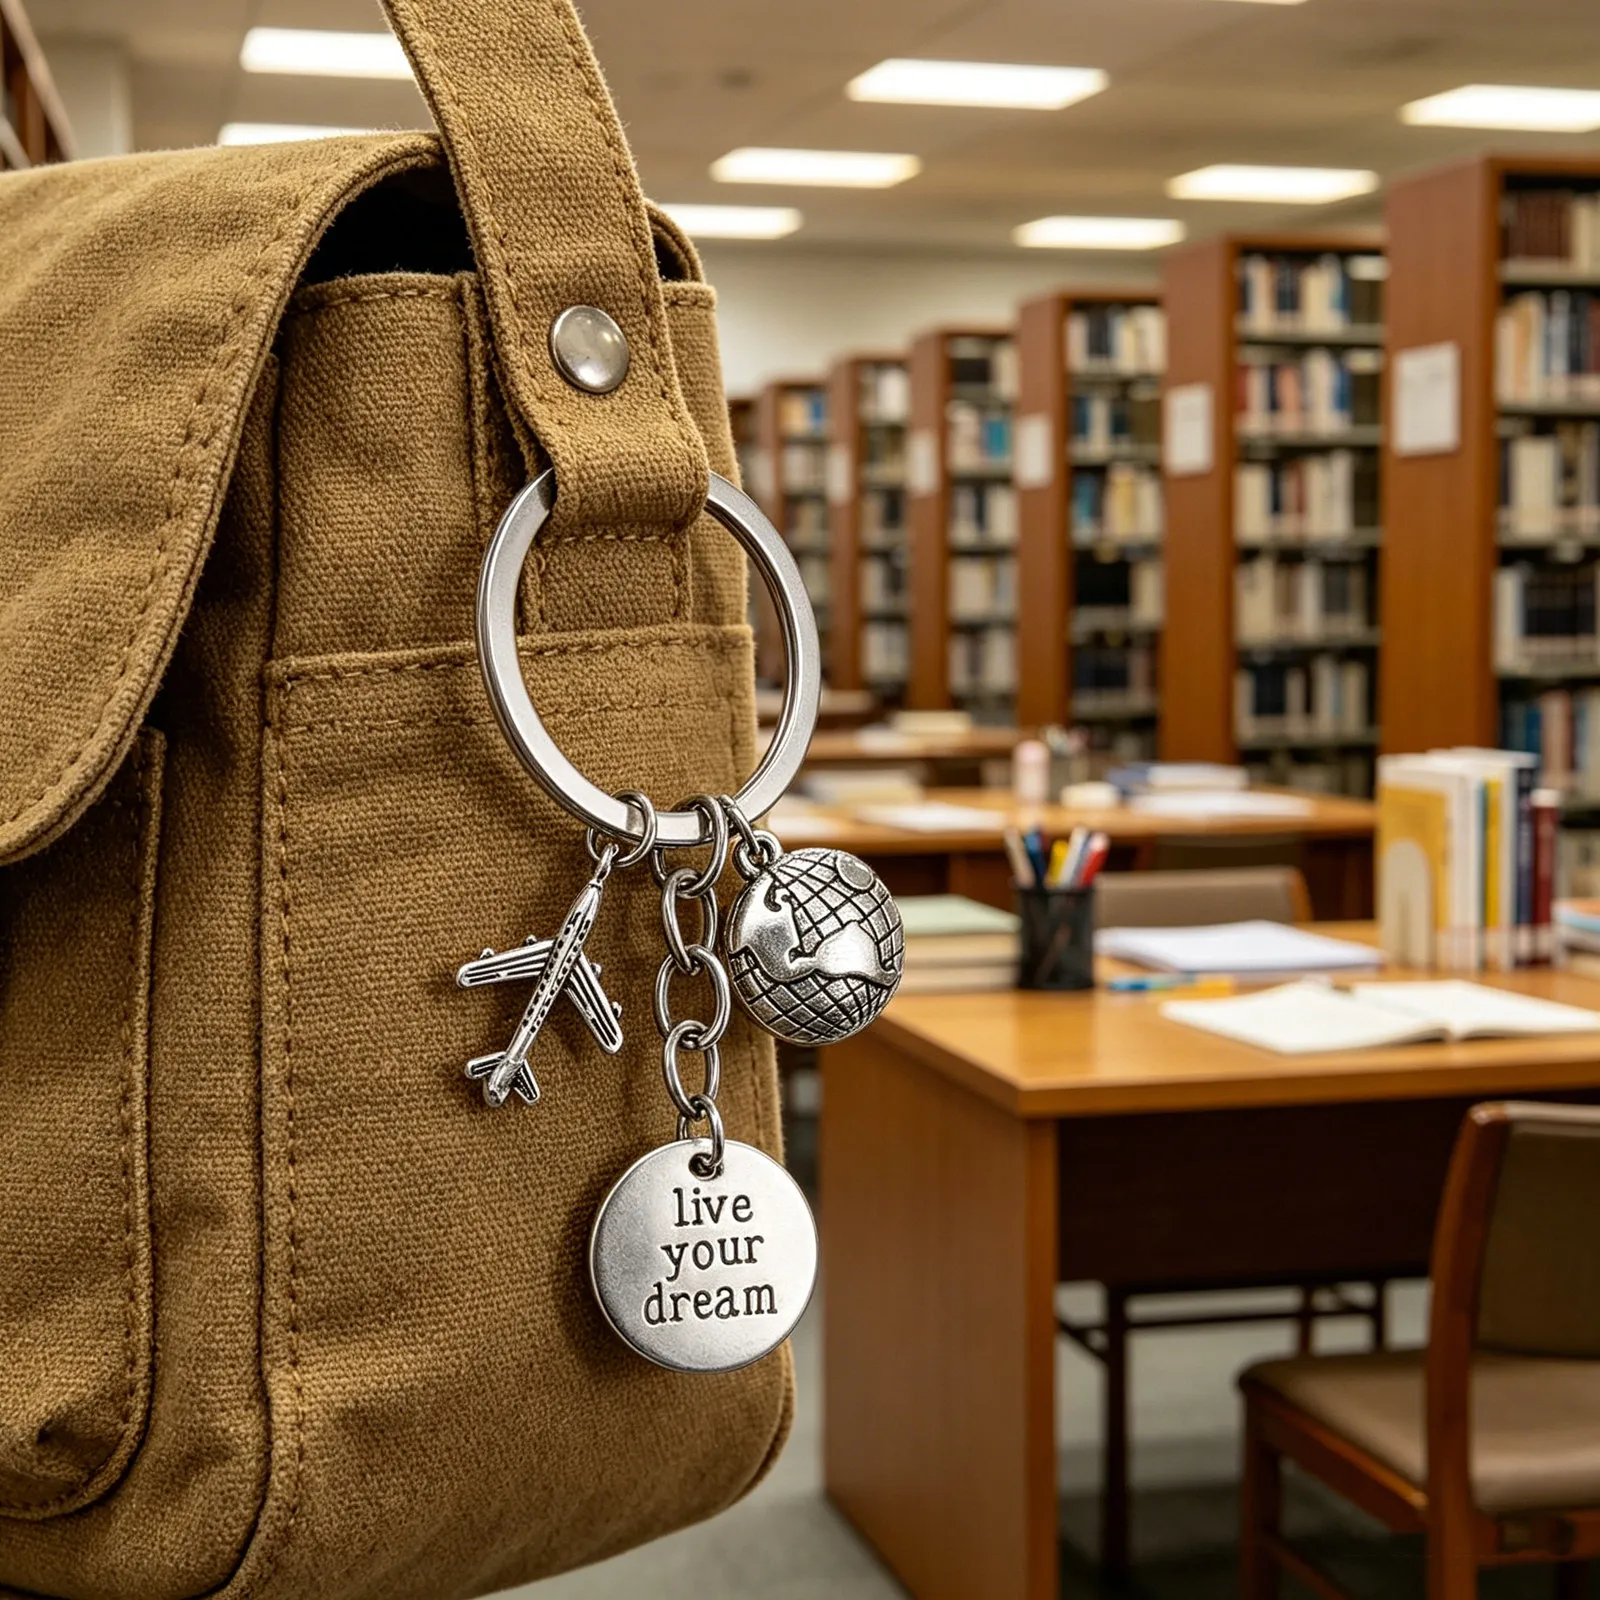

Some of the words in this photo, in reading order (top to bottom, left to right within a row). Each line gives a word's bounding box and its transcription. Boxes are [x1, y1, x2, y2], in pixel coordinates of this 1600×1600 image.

[673, 1187, 754, 1227] live
[660, 1234, 765, 1282] your
[643, 1282, 778, 1326] dream
